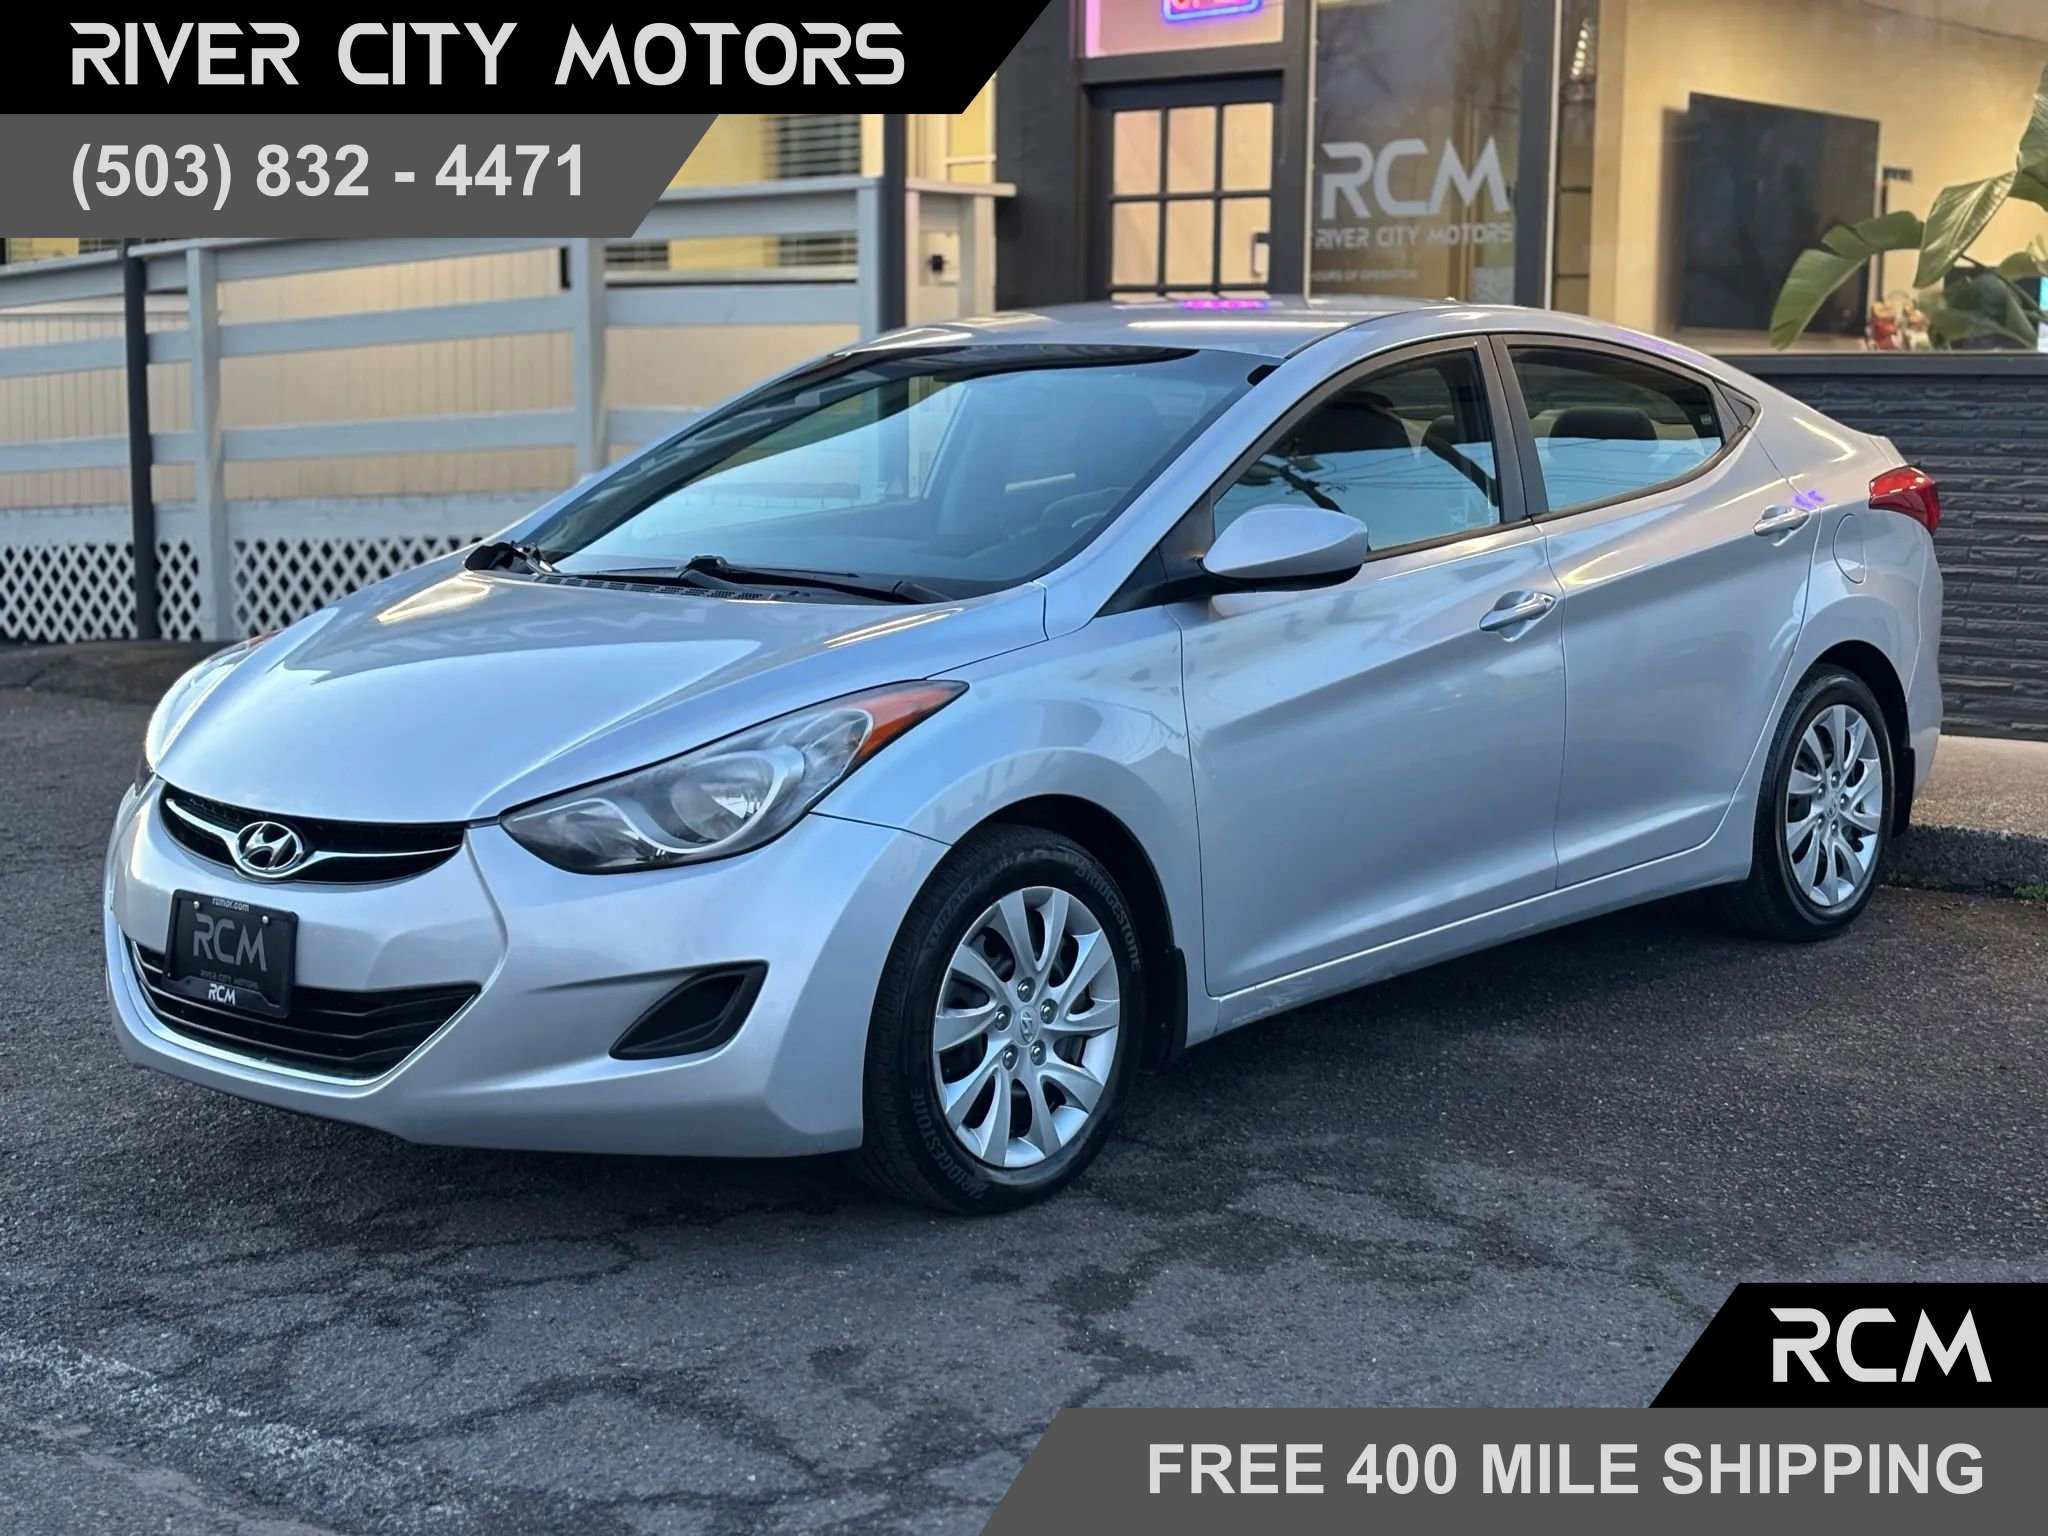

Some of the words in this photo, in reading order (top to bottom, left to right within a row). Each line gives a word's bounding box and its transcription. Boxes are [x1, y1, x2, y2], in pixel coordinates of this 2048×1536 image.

[1321, 135, 1511, 220] RCM
[1315, 228, 1369, 249] RIVER
[1376, 226, 1419, 247] CITY
[1426, 222, 1513, 245] MOTORS
[192, 912, 267, 973] RCM
[208, 982, 236, 1006] RCM
